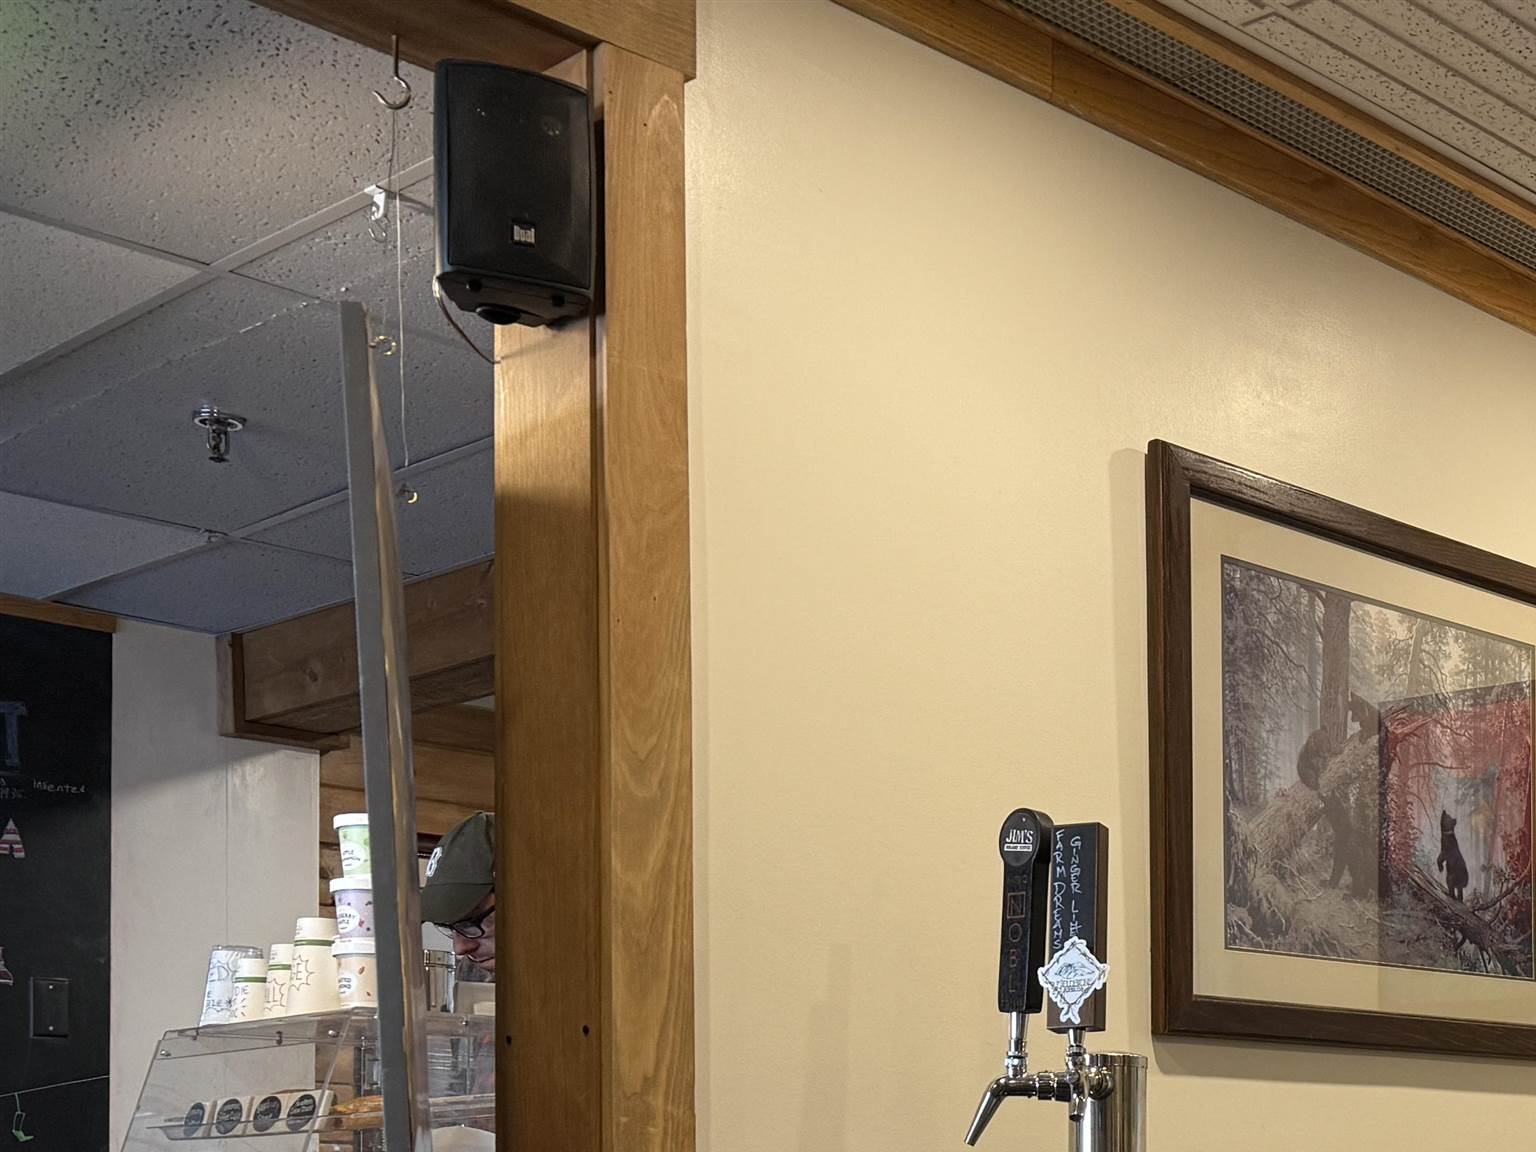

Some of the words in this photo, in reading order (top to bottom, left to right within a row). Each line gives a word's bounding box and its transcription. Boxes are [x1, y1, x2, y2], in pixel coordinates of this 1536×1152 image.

[1005, 829, 1034, 844] JIM'S
[1053, 829, 1066, 877] FARM
[1070, 836, 1082, 893] GINGER
